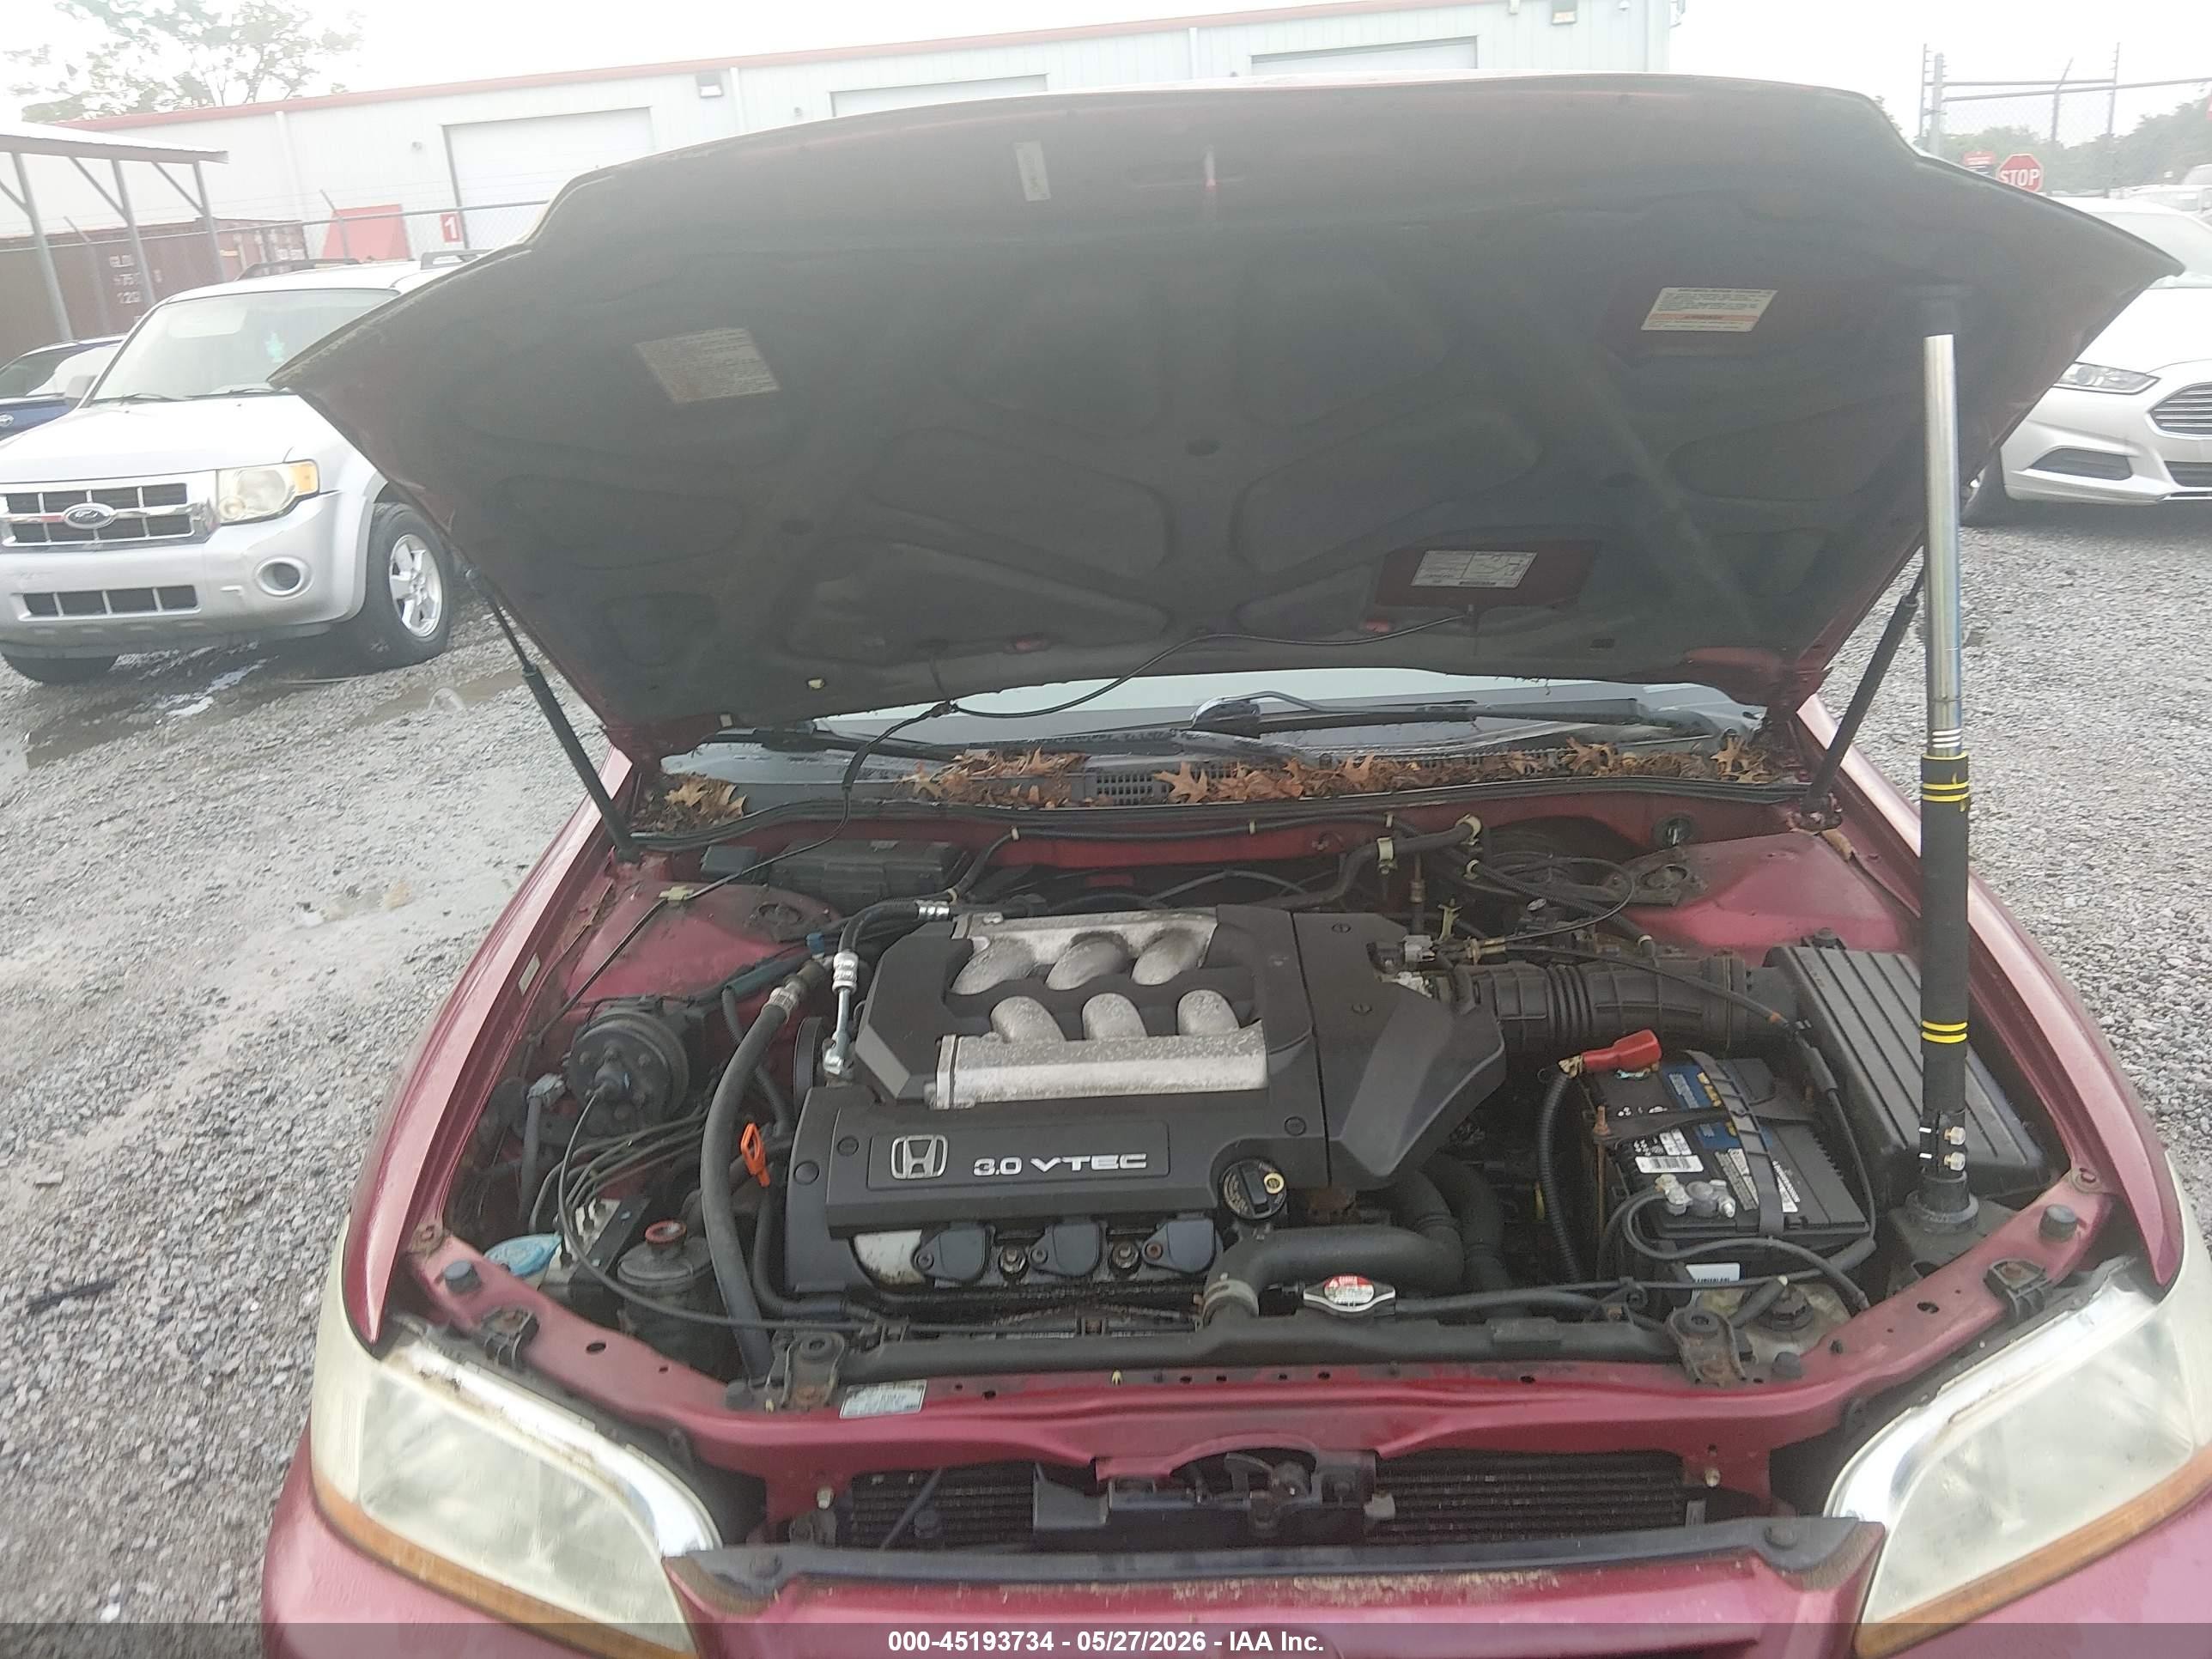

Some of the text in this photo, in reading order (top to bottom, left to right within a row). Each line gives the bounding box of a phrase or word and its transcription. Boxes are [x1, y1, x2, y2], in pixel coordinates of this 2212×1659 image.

[1999, 168, 2040, 185] STOP
[445, 216, 458, 239] 1
[973, 1152, 1147, 1176] 3.0 VTEC
